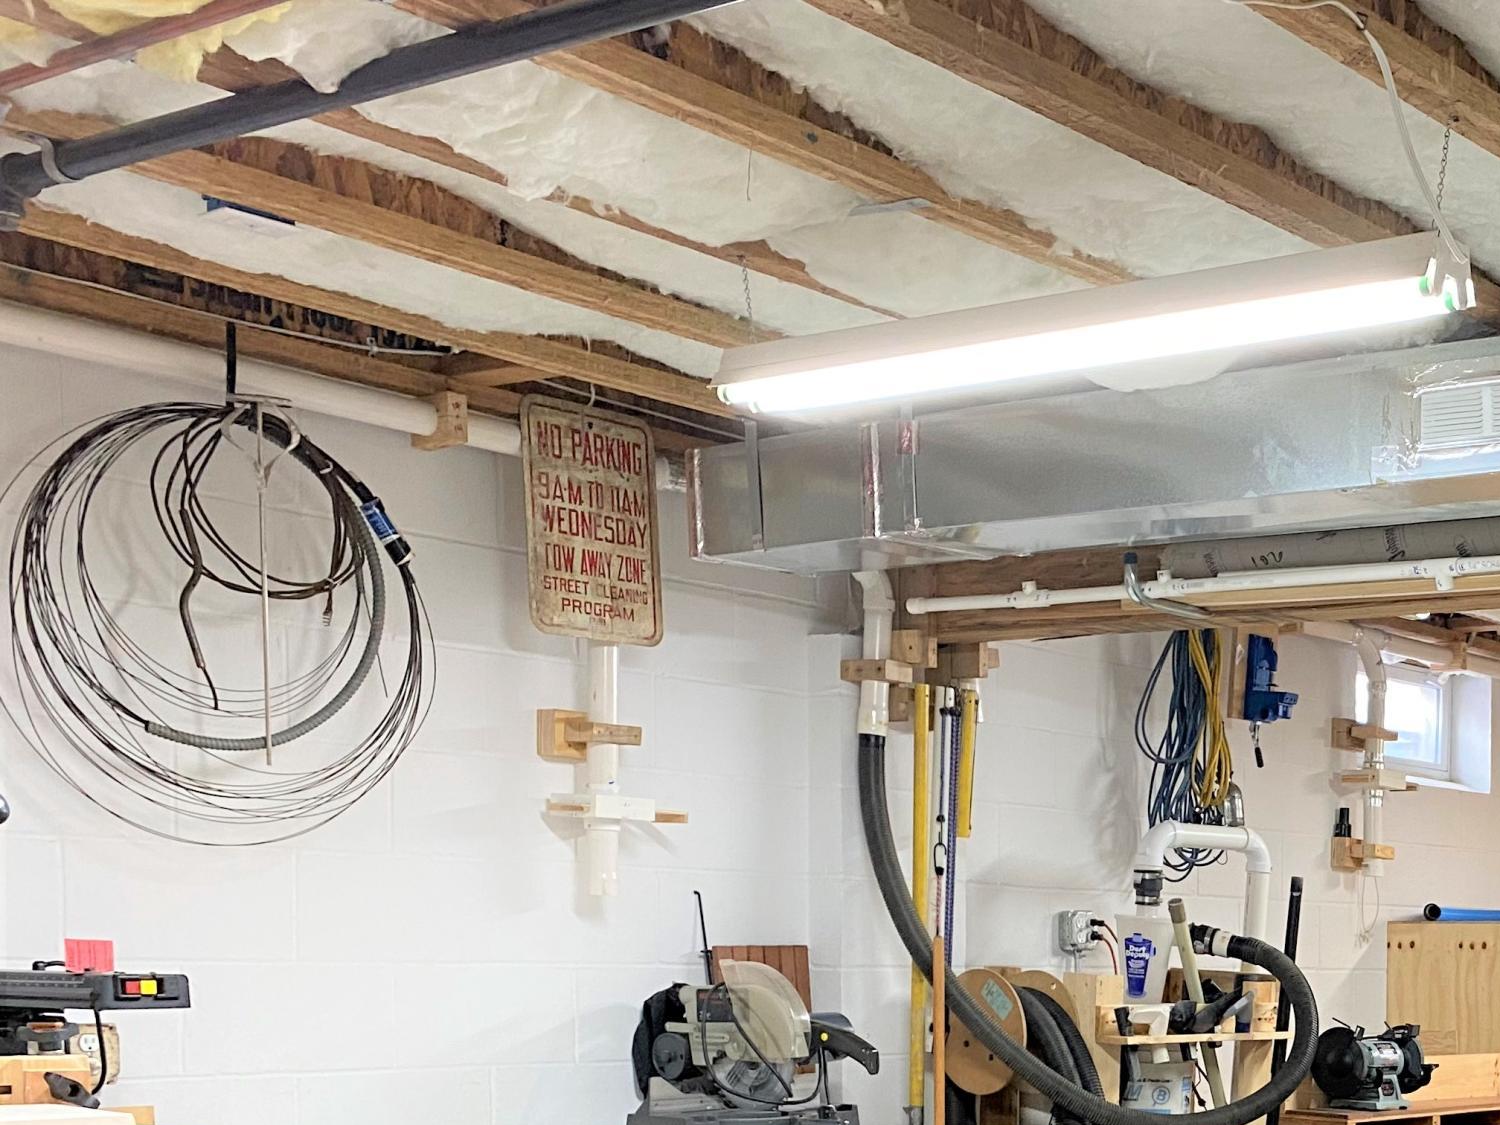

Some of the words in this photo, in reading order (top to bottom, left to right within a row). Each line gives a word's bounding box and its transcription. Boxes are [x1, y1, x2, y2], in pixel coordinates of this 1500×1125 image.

[537, 421, 562, 459] NO
[570, 427, 642, 477] PARKING
[587, 480, 604, 510] TO
[543, 504, 647, 550] WEDNESDAY
[545, 542, 575, 574] TOW
[580, 548, 613, 580] AWAY
[616, 554, 648, 586] ZONE
[543, 575, 589, 596] STREET
[597, 583, 649, 606] CLEANING
[561, 597, 636, 622] PROGRAM
